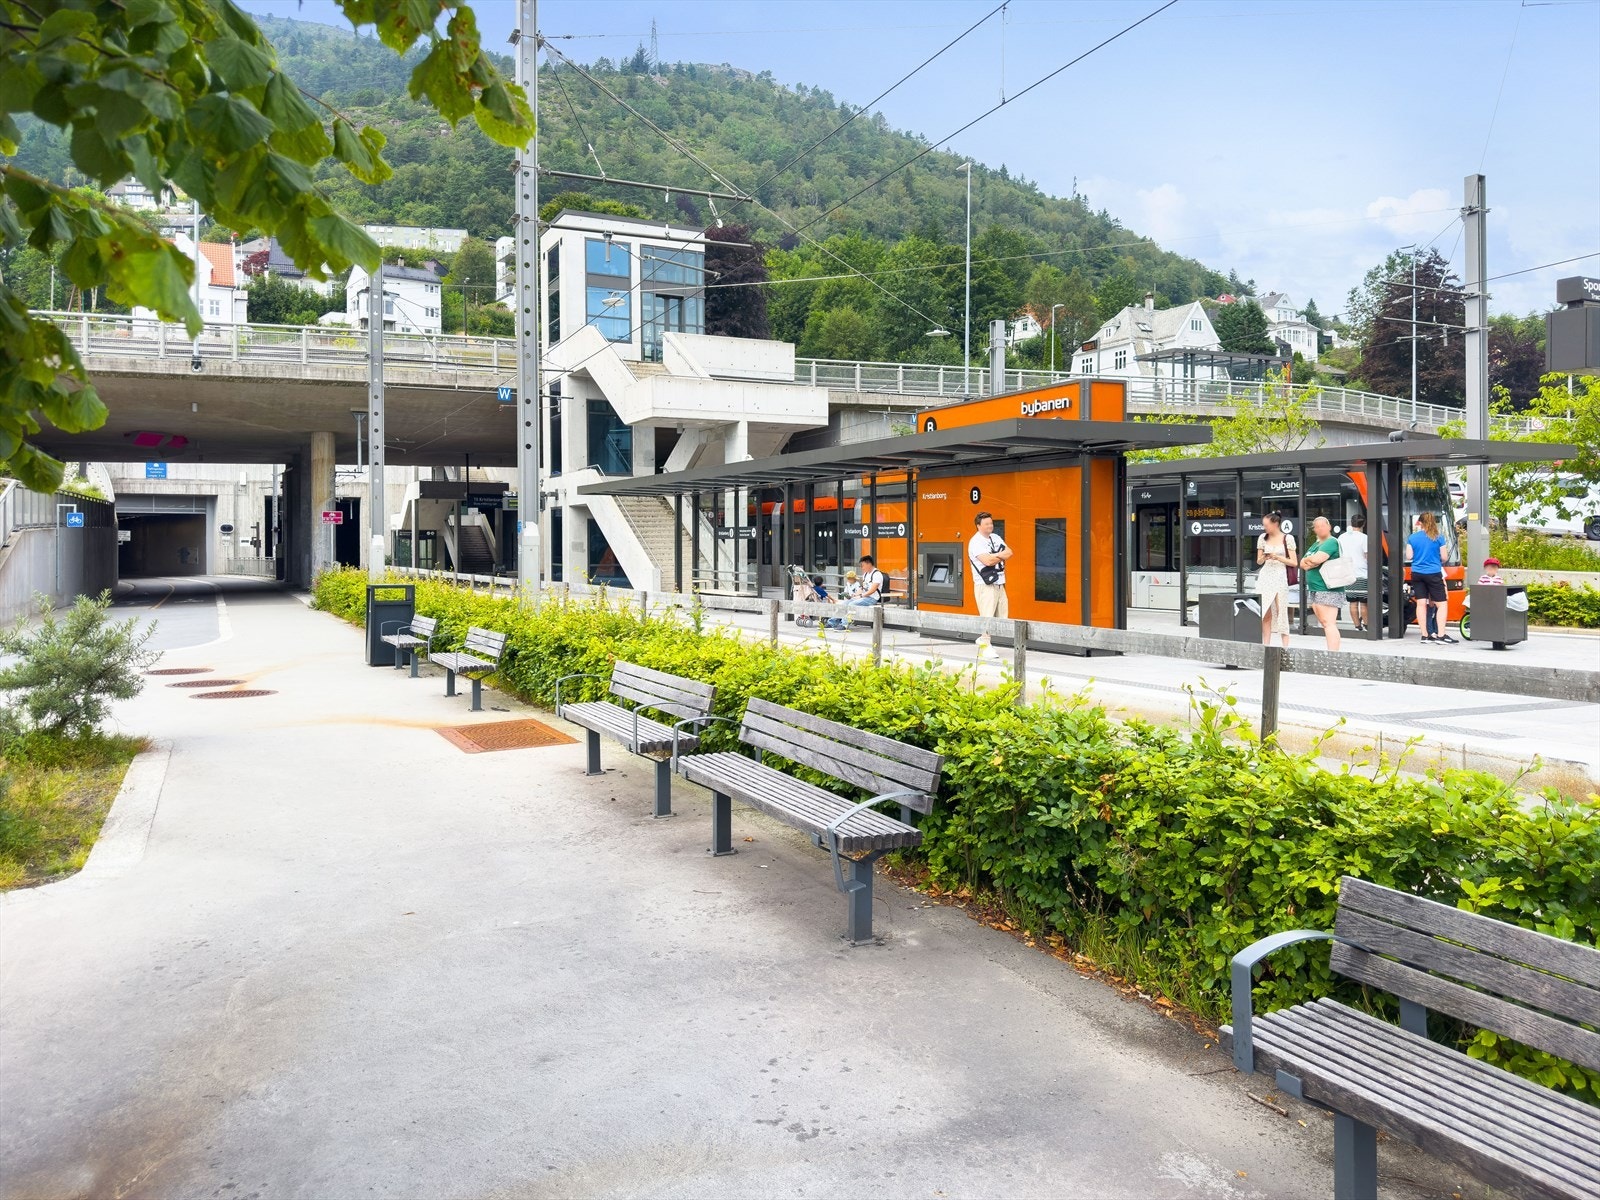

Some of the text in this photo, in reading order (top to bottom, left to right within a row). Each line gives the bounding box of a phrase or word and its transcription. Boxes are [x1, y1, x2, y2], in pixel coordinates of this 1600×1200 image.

[499, 388, 510, 400] W
[1021, 398, 1070, 416] bybanen
[1271, 481, 1300, 491] bybane
[972, 490, 978, 501] B
